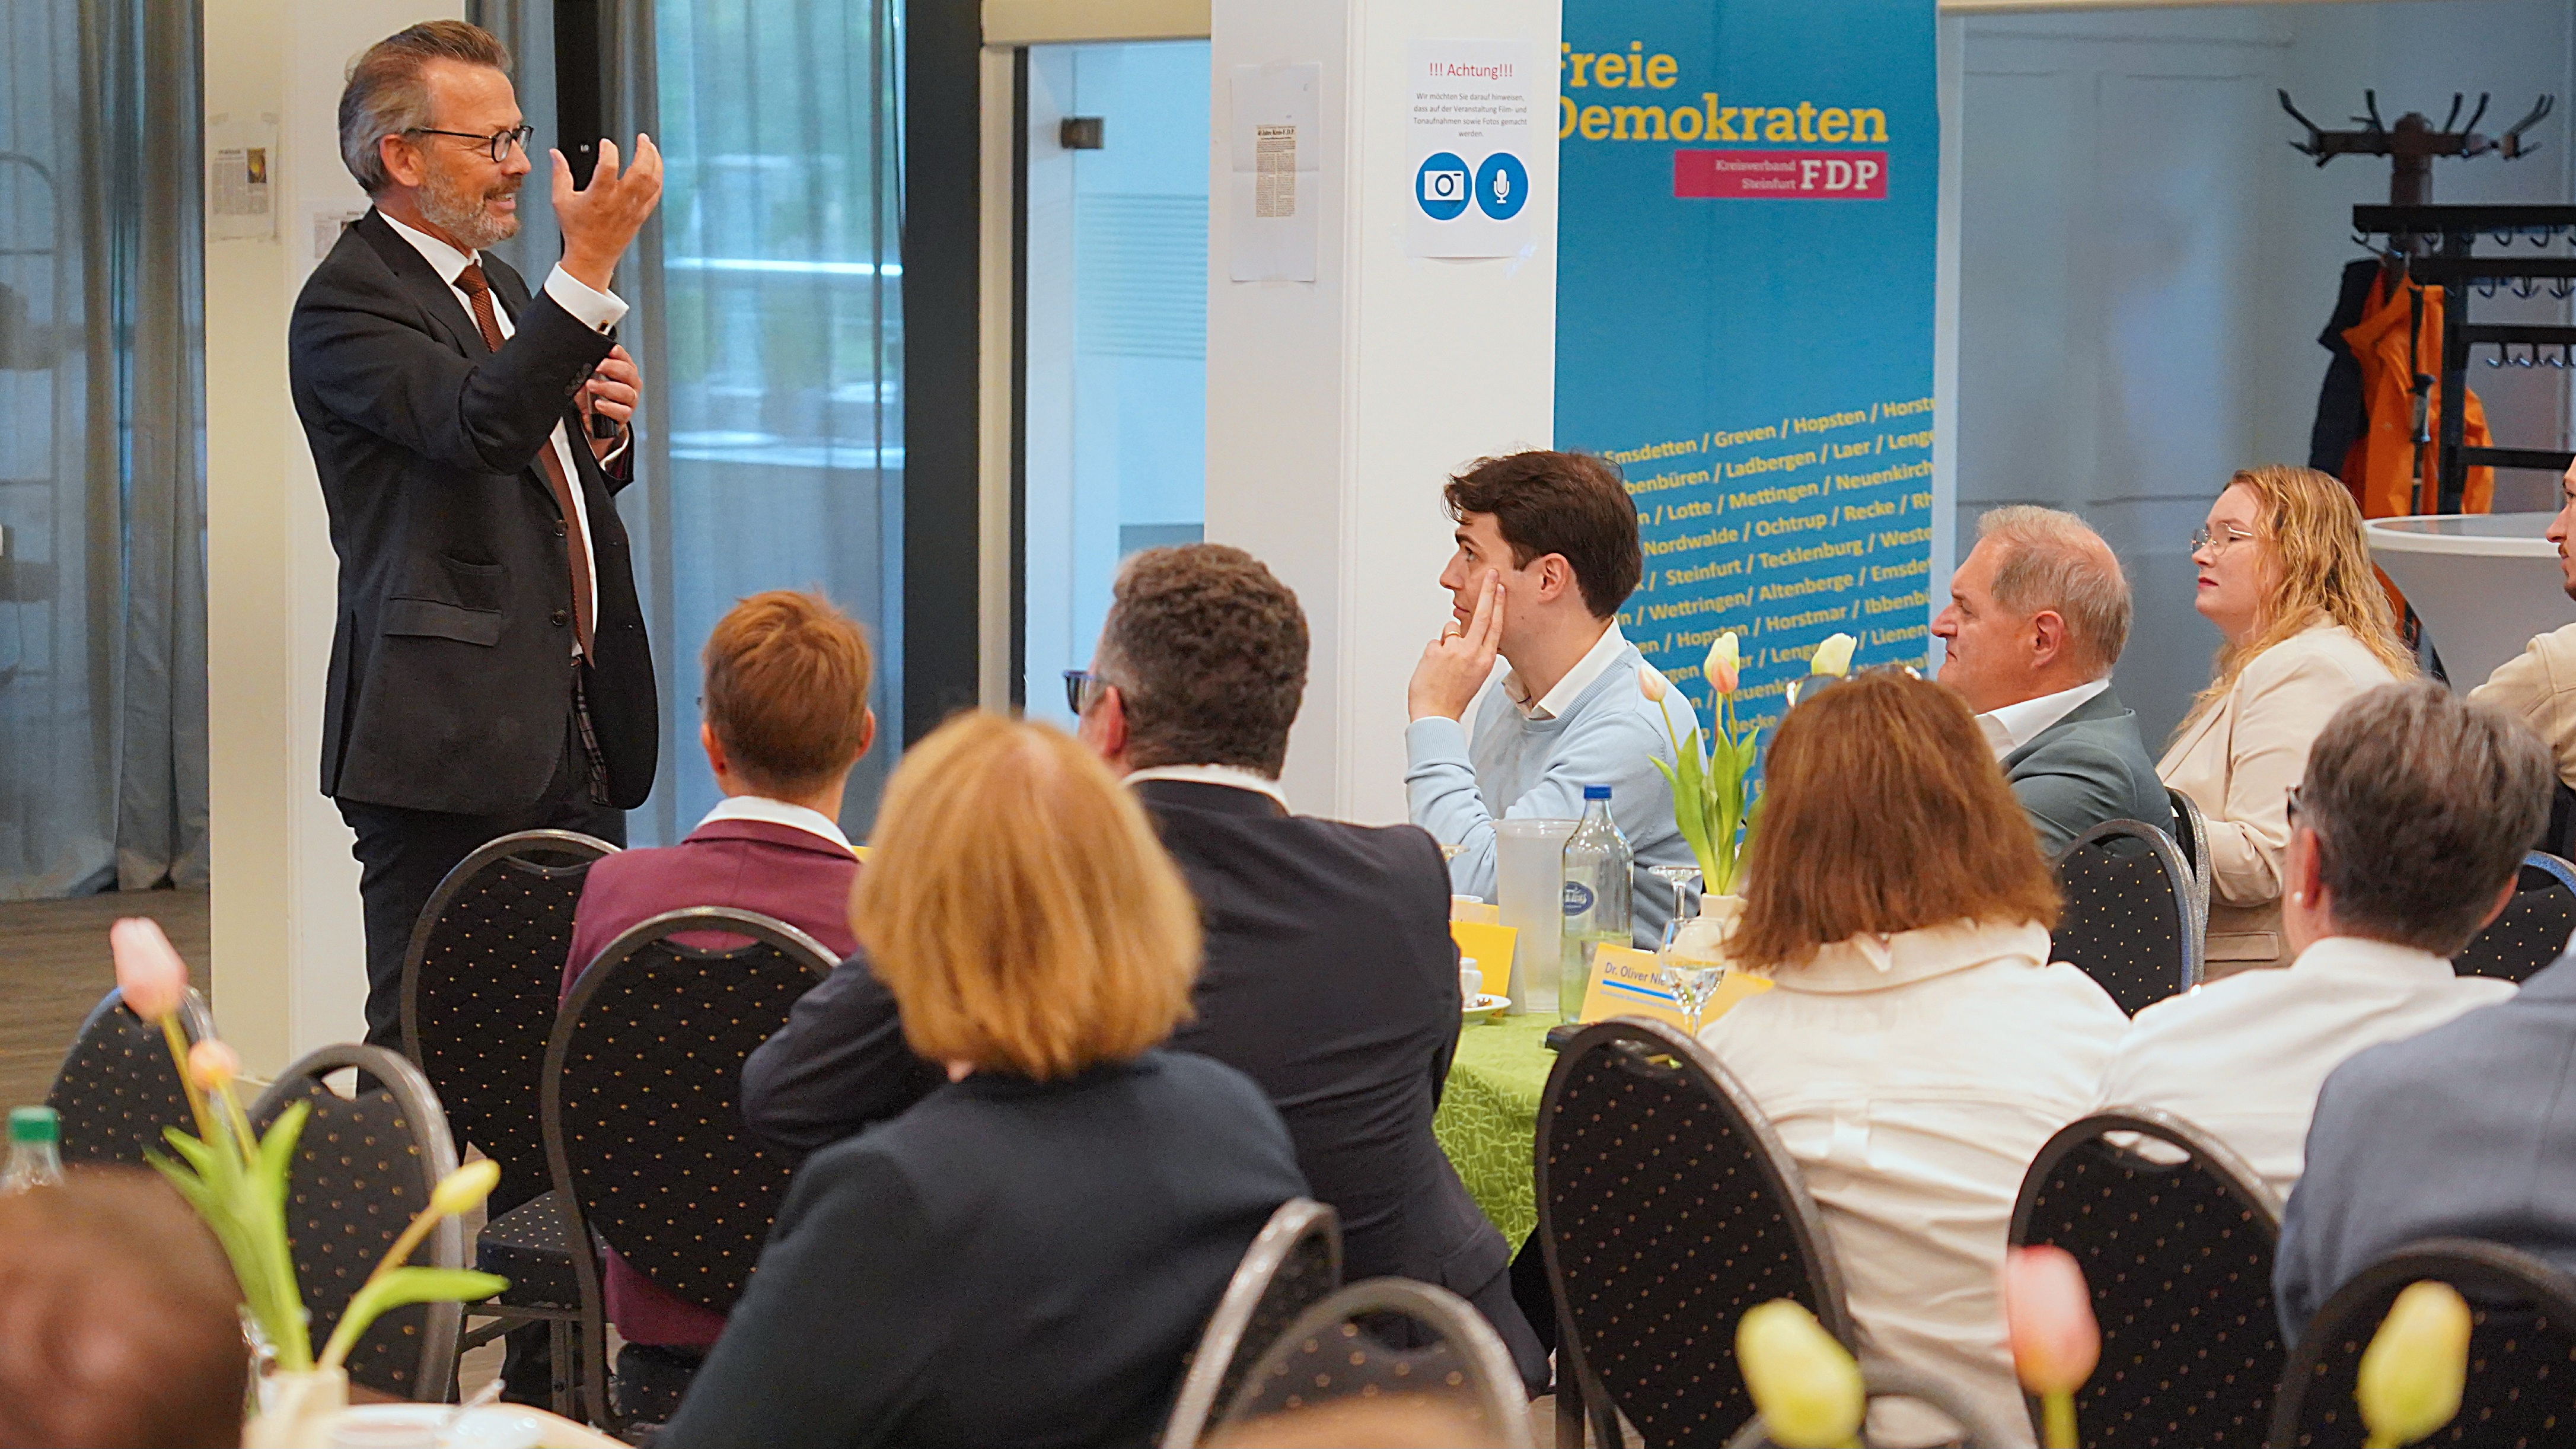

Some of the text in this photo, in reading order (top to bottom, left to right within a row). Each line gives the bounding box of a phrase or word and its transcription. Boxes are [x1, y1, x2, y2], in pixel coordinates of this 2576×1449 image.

[1430, 62, 1513, 80] !!! Achtung!!!
[1716, 158, 1796, 171] Kreisverband
[1800, 159, 1879, 190] FDP
[1742, 177, 1796, 190] Steinfurt
[1714, 425, 1776, 448] Greven
[1793, 410, 1866, 433] Hopsten
[1883, 397, 1934, 418] Horst
[1624, 470, 1709, 495] benbüren
[1726, 451, 1816, 477] Ladbergen
[1833, 441, 1870, 458] Laer
[1668, 501, 1712, 521] Lotte
[1729, 483, 1818, 509] Mettingen
[1836, 460, 1934, 490] Neuenkirch
[1643, 527, 1739, 556] Nordwalde
[1755, 514, 1826, 537] Ochtrup
[1844, 501, 1895, 521] Recke
[1665, 559, 1742, 585] Steinfurt
[1758, 540, 1863, 568] Tecklenburg
[1759, 574, 1854, 601] Altenberge
[1765, 606, 1847, 632] Horstmar
[1871, 623, 1928, 646] Lienen
[1605, 962, 1617, 975] Dr.
[1621, 966, 1648, 982] Oliver
